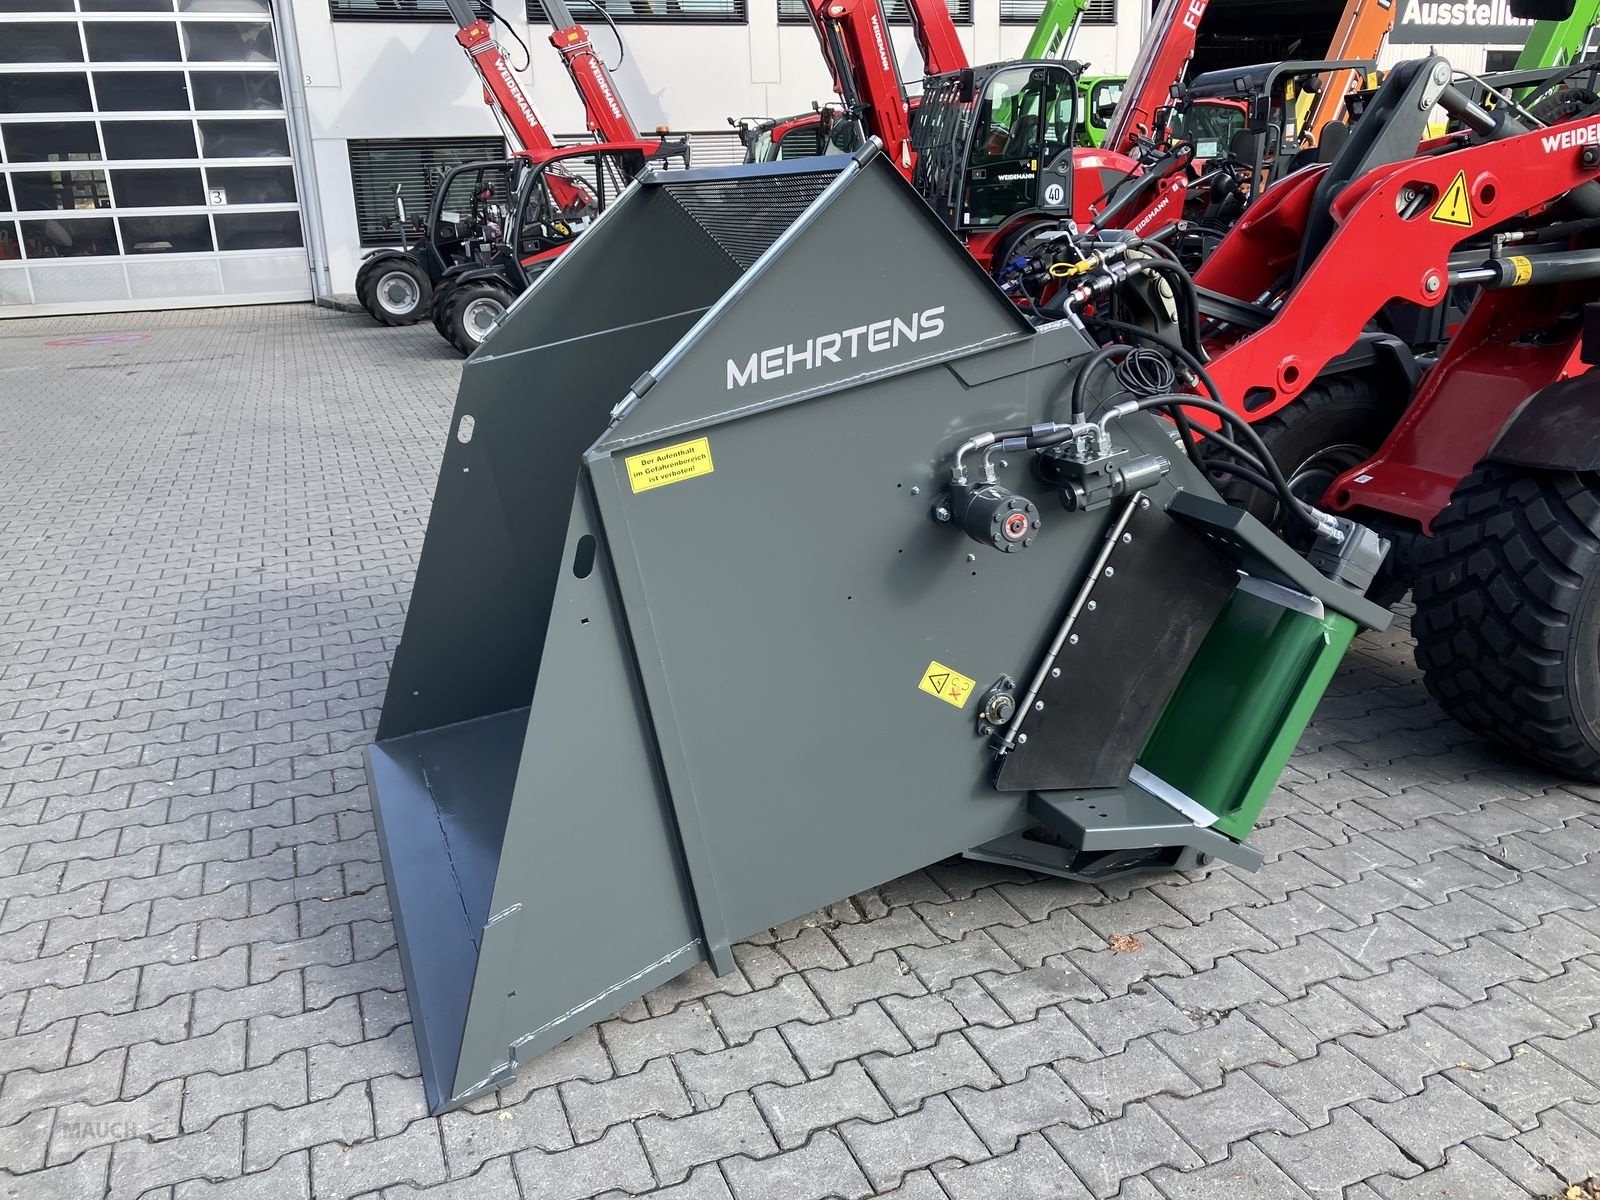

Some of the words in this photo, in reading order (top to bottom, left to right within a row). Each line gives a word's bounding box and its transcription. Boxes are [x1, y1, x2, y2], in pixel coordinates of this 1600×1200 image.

[871, 14, 890, 71] WEIDEMANN
[305, 75, 312, 85] 3
[588, 57, 622, 119] WEIDEMANN
[494, 57, 538, 127] WEIDEMANN
[1541, 122, 1600, 154] WEIDE
[998, 173, 1035, 181] WEIDEMANN
[212, 191, 222, 204] 3
[1048, 188, 1060, 201] 40
[726, 305, 945, 390] MEHRTENS
[645, 453, 707, 474] Gefahrenbereich
[656, 447, 695, 462] Aufenthalt
[660, 465, 696, 480] verboten!
